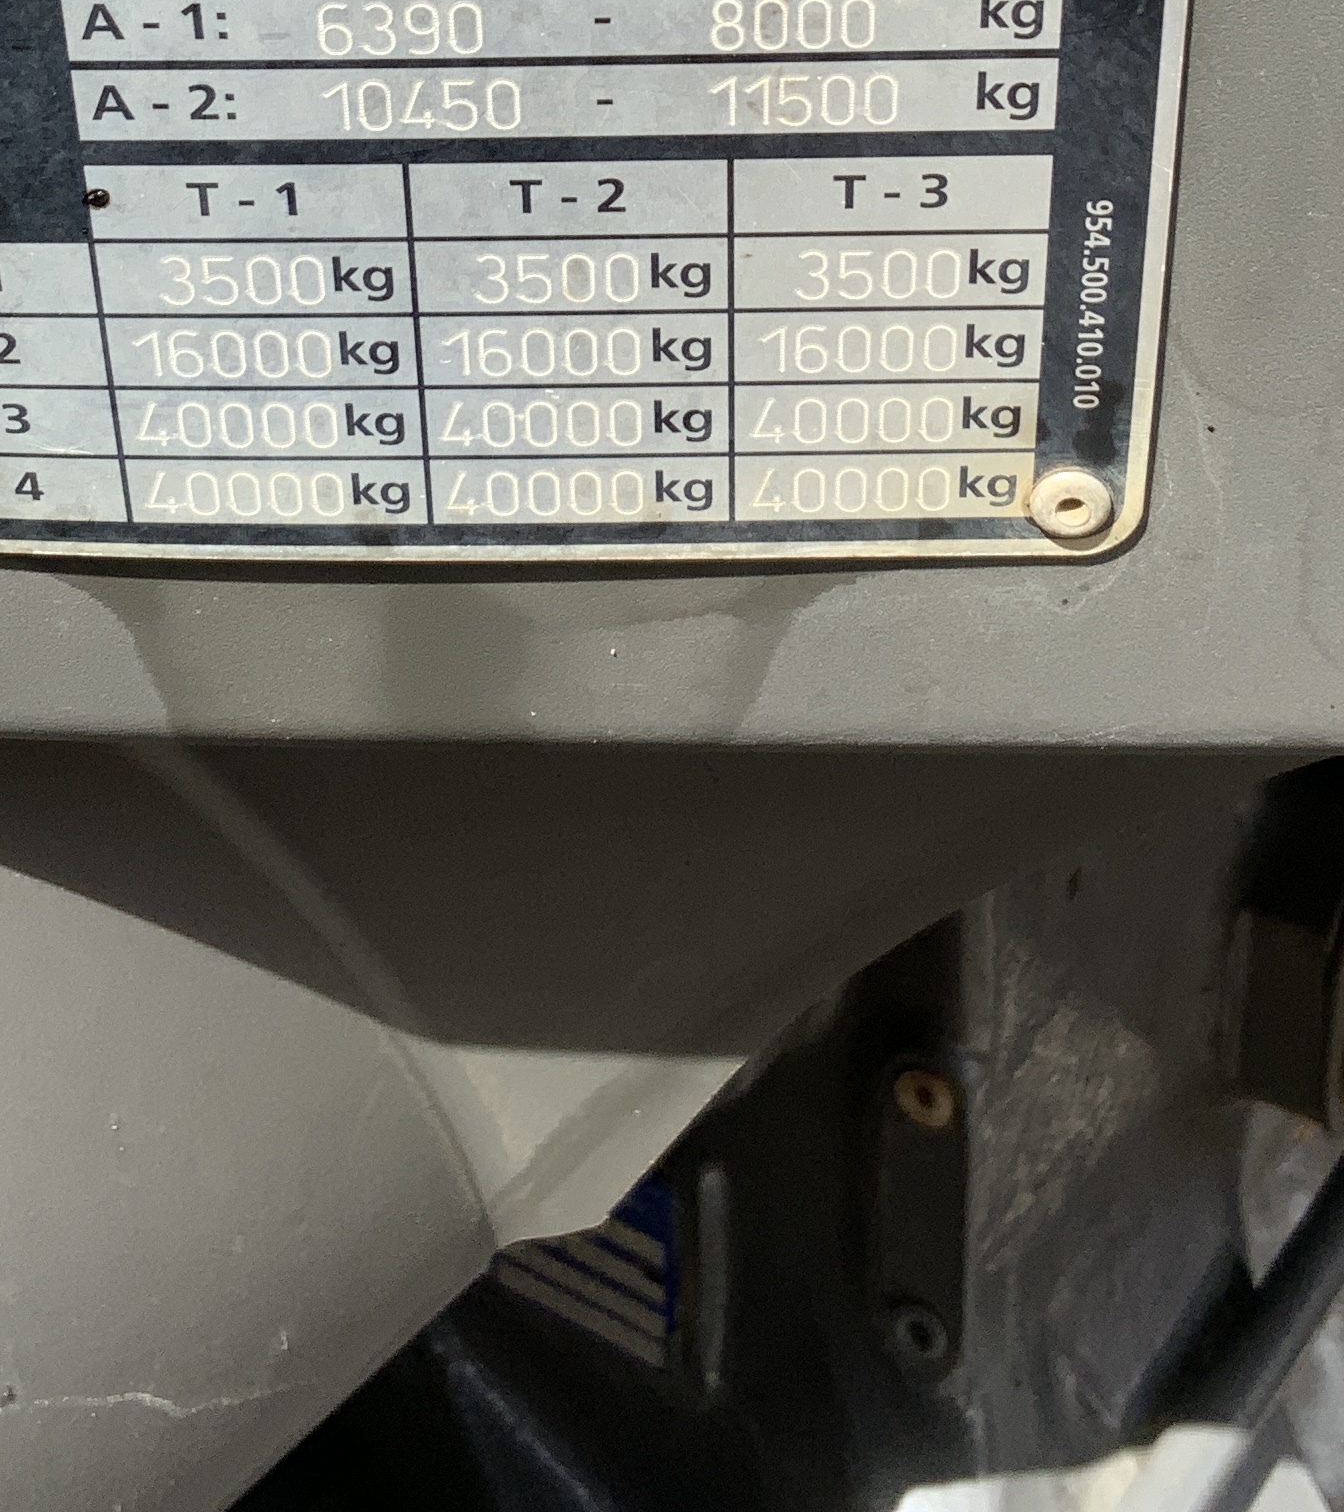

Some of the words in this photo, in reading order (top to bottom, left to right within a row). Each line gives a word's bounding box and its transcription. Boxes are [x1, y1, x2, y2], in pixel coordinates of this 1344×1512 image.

[315, 0, 484, 56] 6390
[322, 79, 523, 133] 10450
[708, 73, 900, 127] 11500
[976, 71, 1041, 121] kg
[1072, 199, 1114, 410] 954.500.410.010
